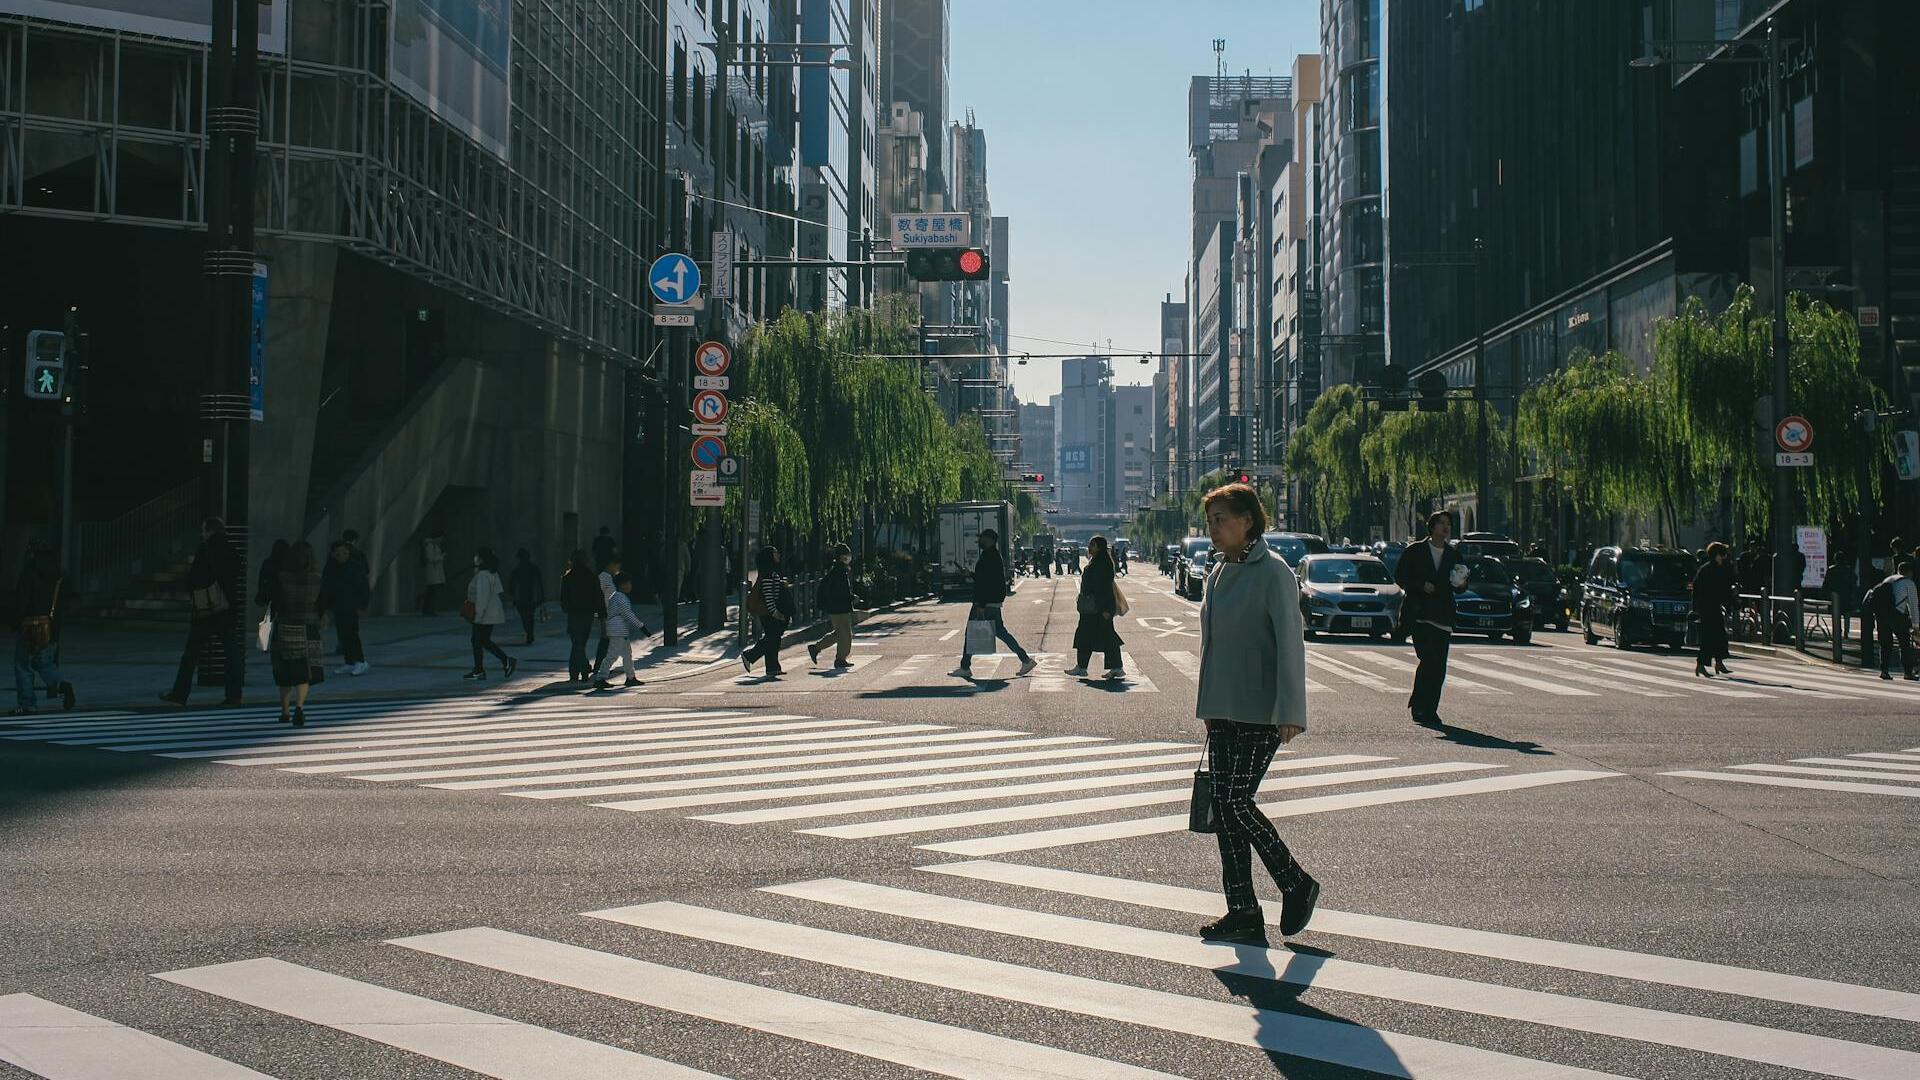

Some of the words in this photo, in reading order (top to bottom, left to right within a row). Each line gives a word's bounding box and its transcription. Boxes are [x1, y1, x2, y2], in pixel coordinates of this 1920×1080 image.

[1740, 74, 1769, 107] TOKY
[897, 217, 963, 232] 数寄屋橋
[903, 233, 957, 244] Sukiyabashi
[717, 235, 728, 296] スクランブル式
